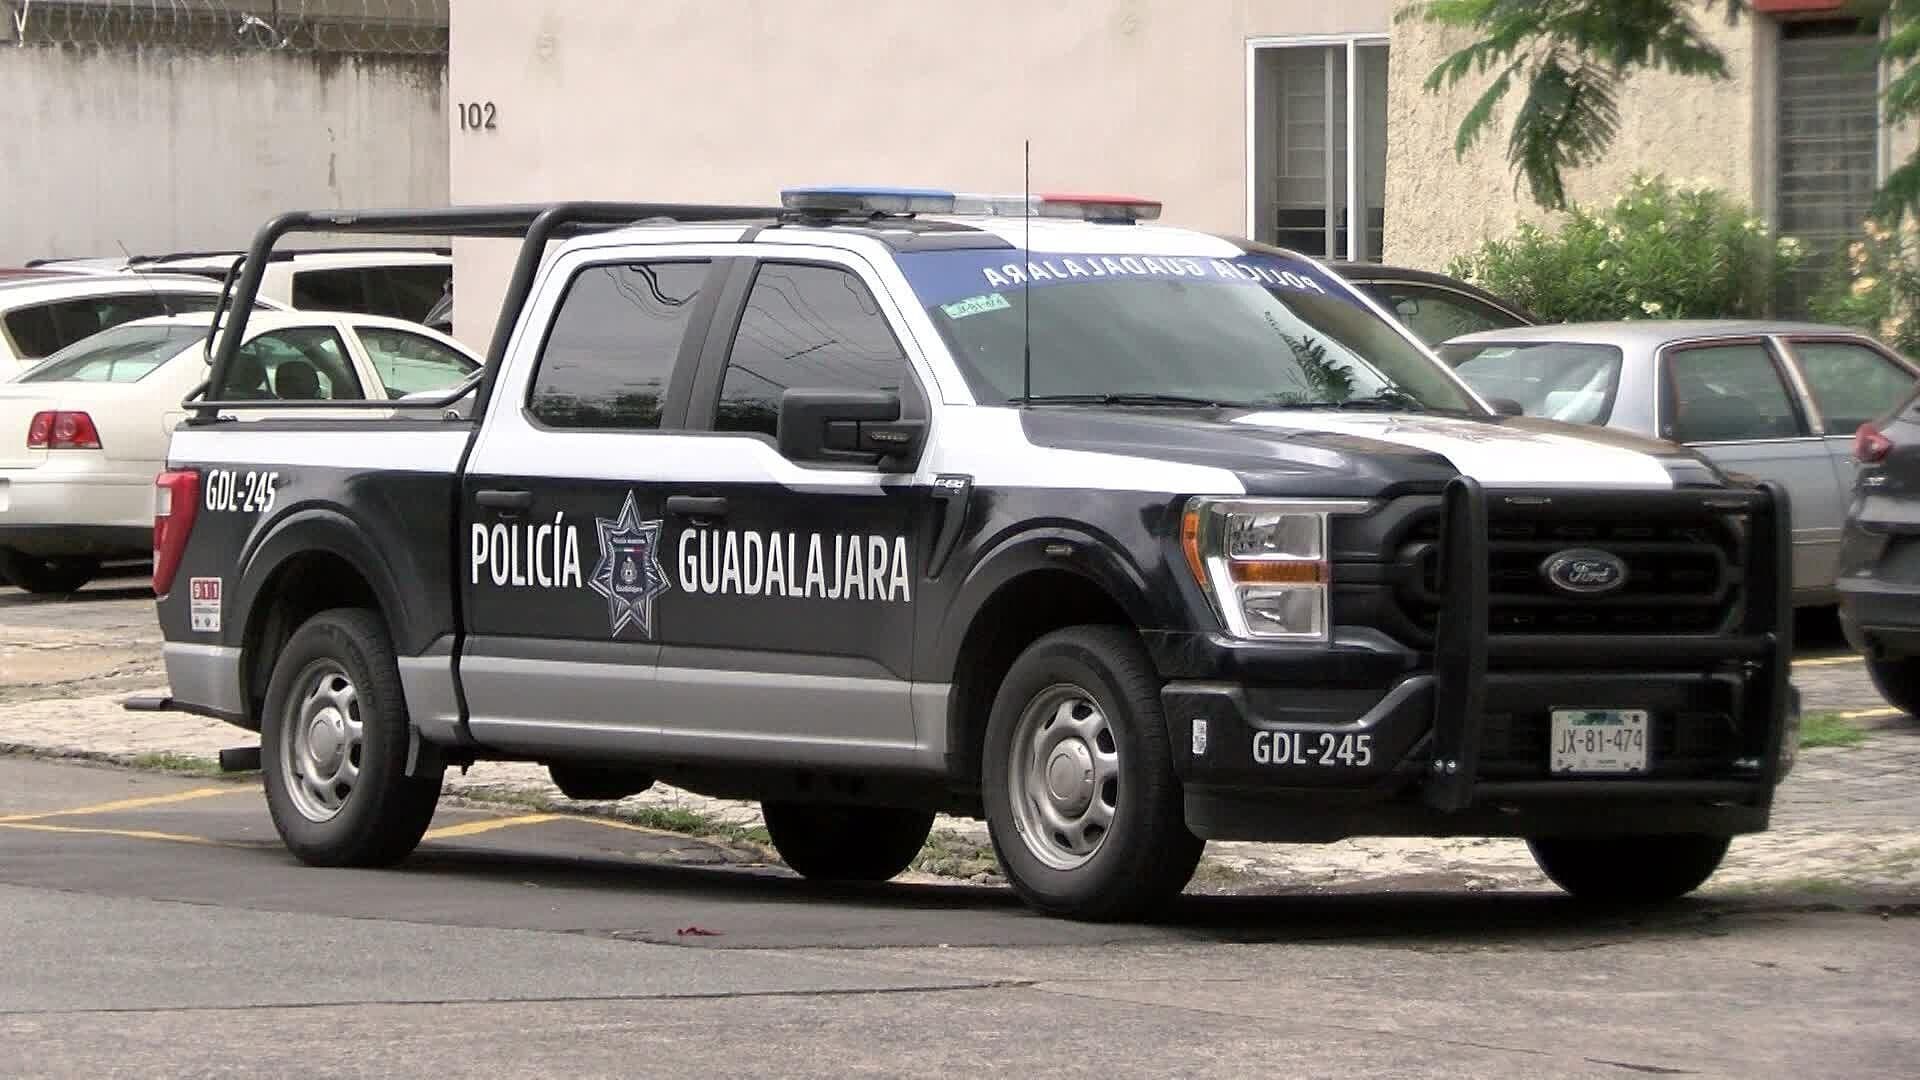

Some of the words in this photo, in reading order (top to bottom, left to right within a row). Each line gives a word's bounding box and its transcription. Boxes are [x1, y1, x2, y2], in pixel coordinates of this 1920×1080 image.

[457, 101, 497, 131] 102
[206, 468, 279, 513] GDL-245
[471, 510, 582, 588] POLICÍA
[678, 527, 911, 603] GUADALAJARA
[1568, 560, 1609, 583] Ford
[193, 583, 218, 598] 911
[1252, 731, 1371, 766] GDL-245
[1557, 729, 1643, 754] JX-81-474
